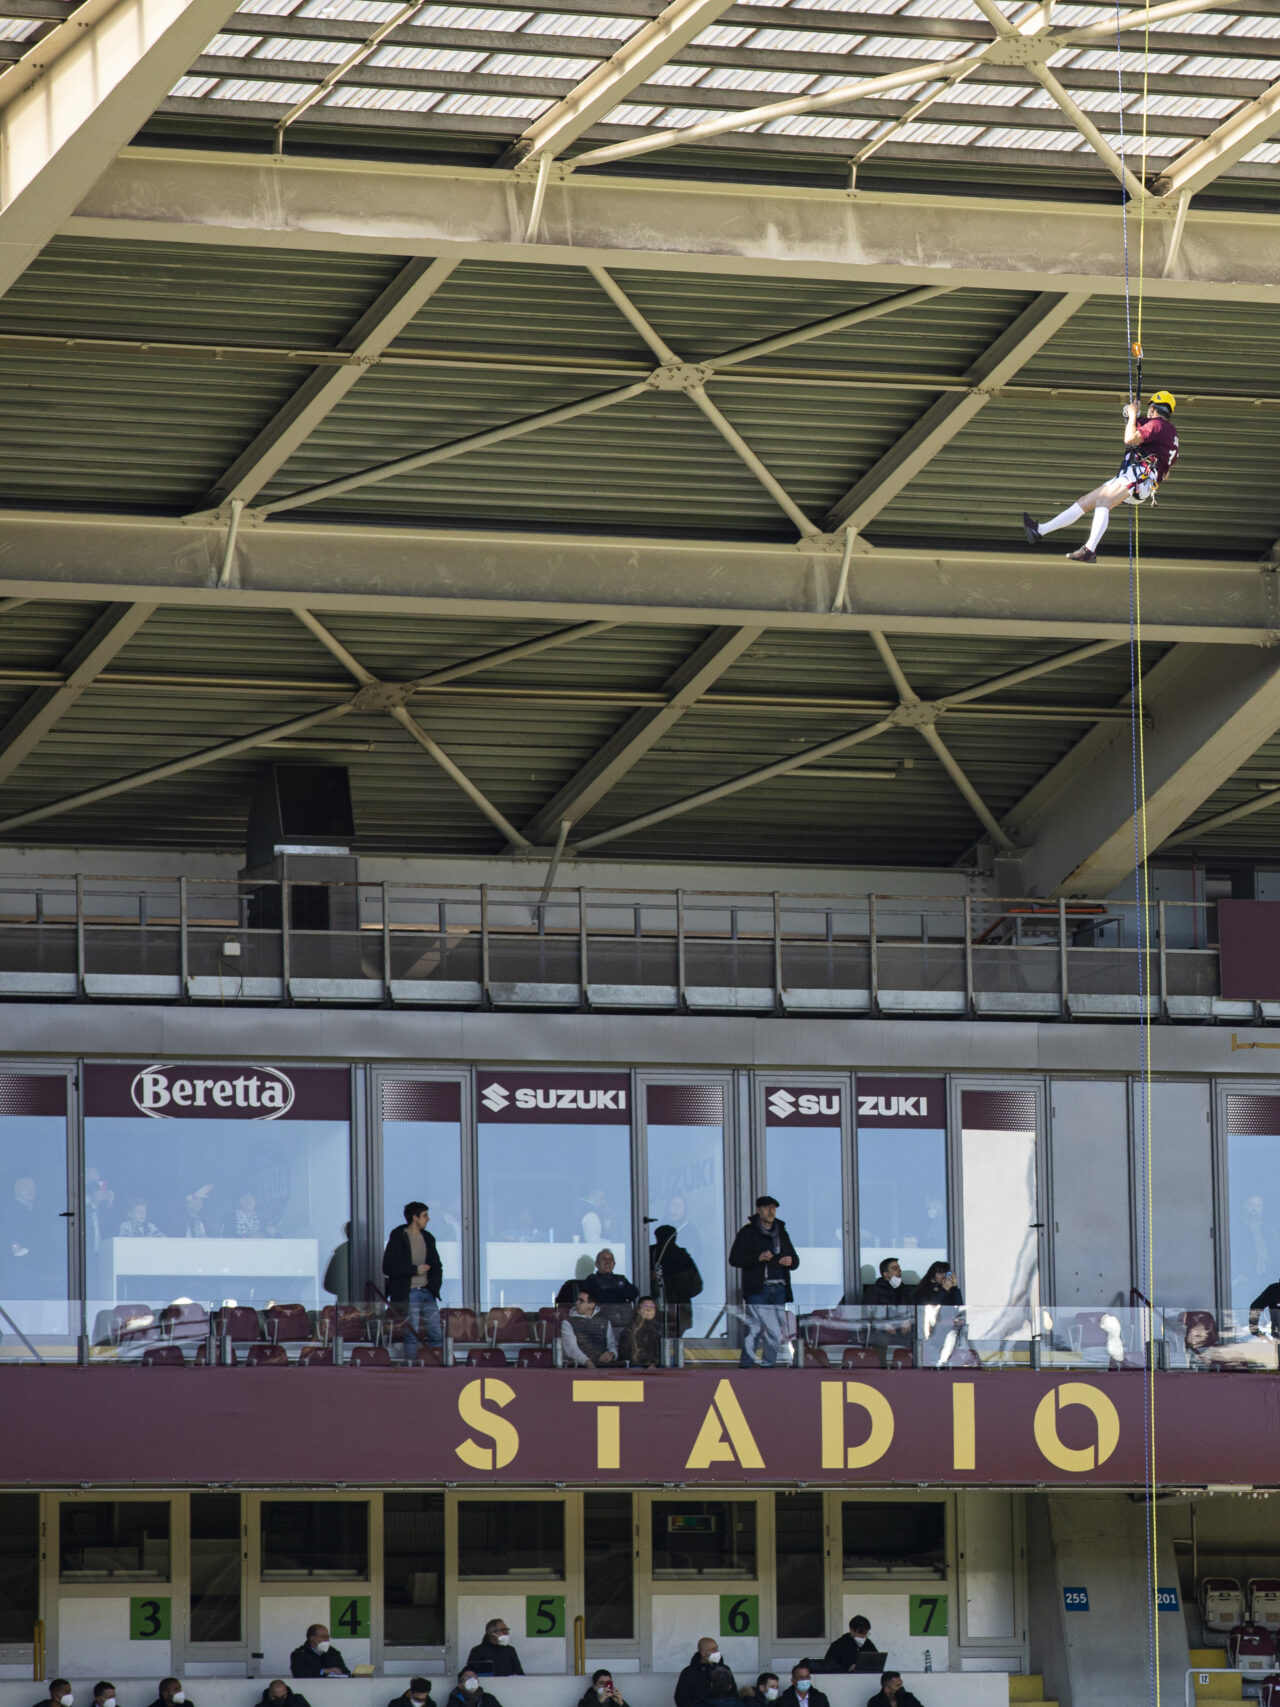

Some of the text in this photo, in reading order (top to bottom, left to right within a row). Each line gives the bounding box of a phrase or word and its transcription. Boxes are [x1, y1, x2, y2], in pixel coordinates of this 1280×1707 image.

[140, 1073, 285, 1109] Beretta
[515, 1088, 626, 1110] SUZUKI
[455, 1378, 1120, 1472] STADIO
[535, 1597, 557, 1635] 5
[727, 1597, 751, 1634] 6
[918, 1597, 939, 1634] 7
[1065, 1593, 1087, 1604] 255
[1156, 1593, 1177, 1604] 201
[139, 1600, 162, 1637] 3
[337, 1599, 363, 1636] 4
